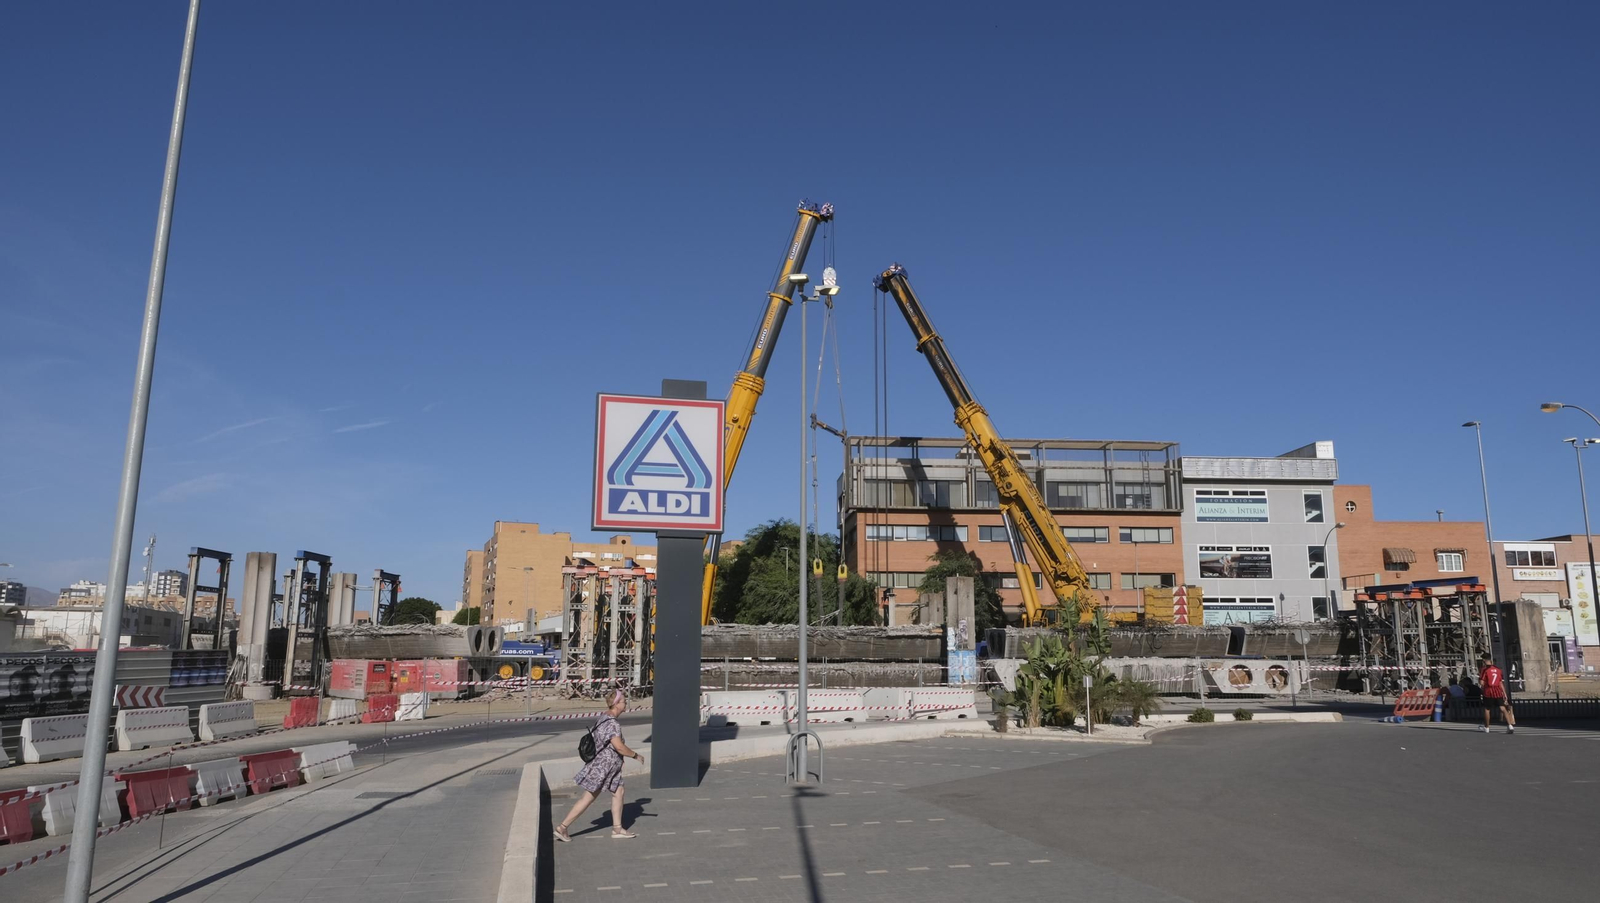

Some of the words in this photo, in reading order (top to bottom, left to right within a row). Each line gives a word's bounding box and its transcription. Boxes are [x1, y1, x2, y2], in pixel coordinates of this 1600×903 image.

[617, 491, 701, 515] ALDI
[1198, 506, 1228, 515] ALIANZA
[1237, 506, 1266, 515] INTERIM
[5, 658, 44, 666] PECOS
[46, 656, 81, 665] PECOS
[1491, 673, 1497, 685] 7
